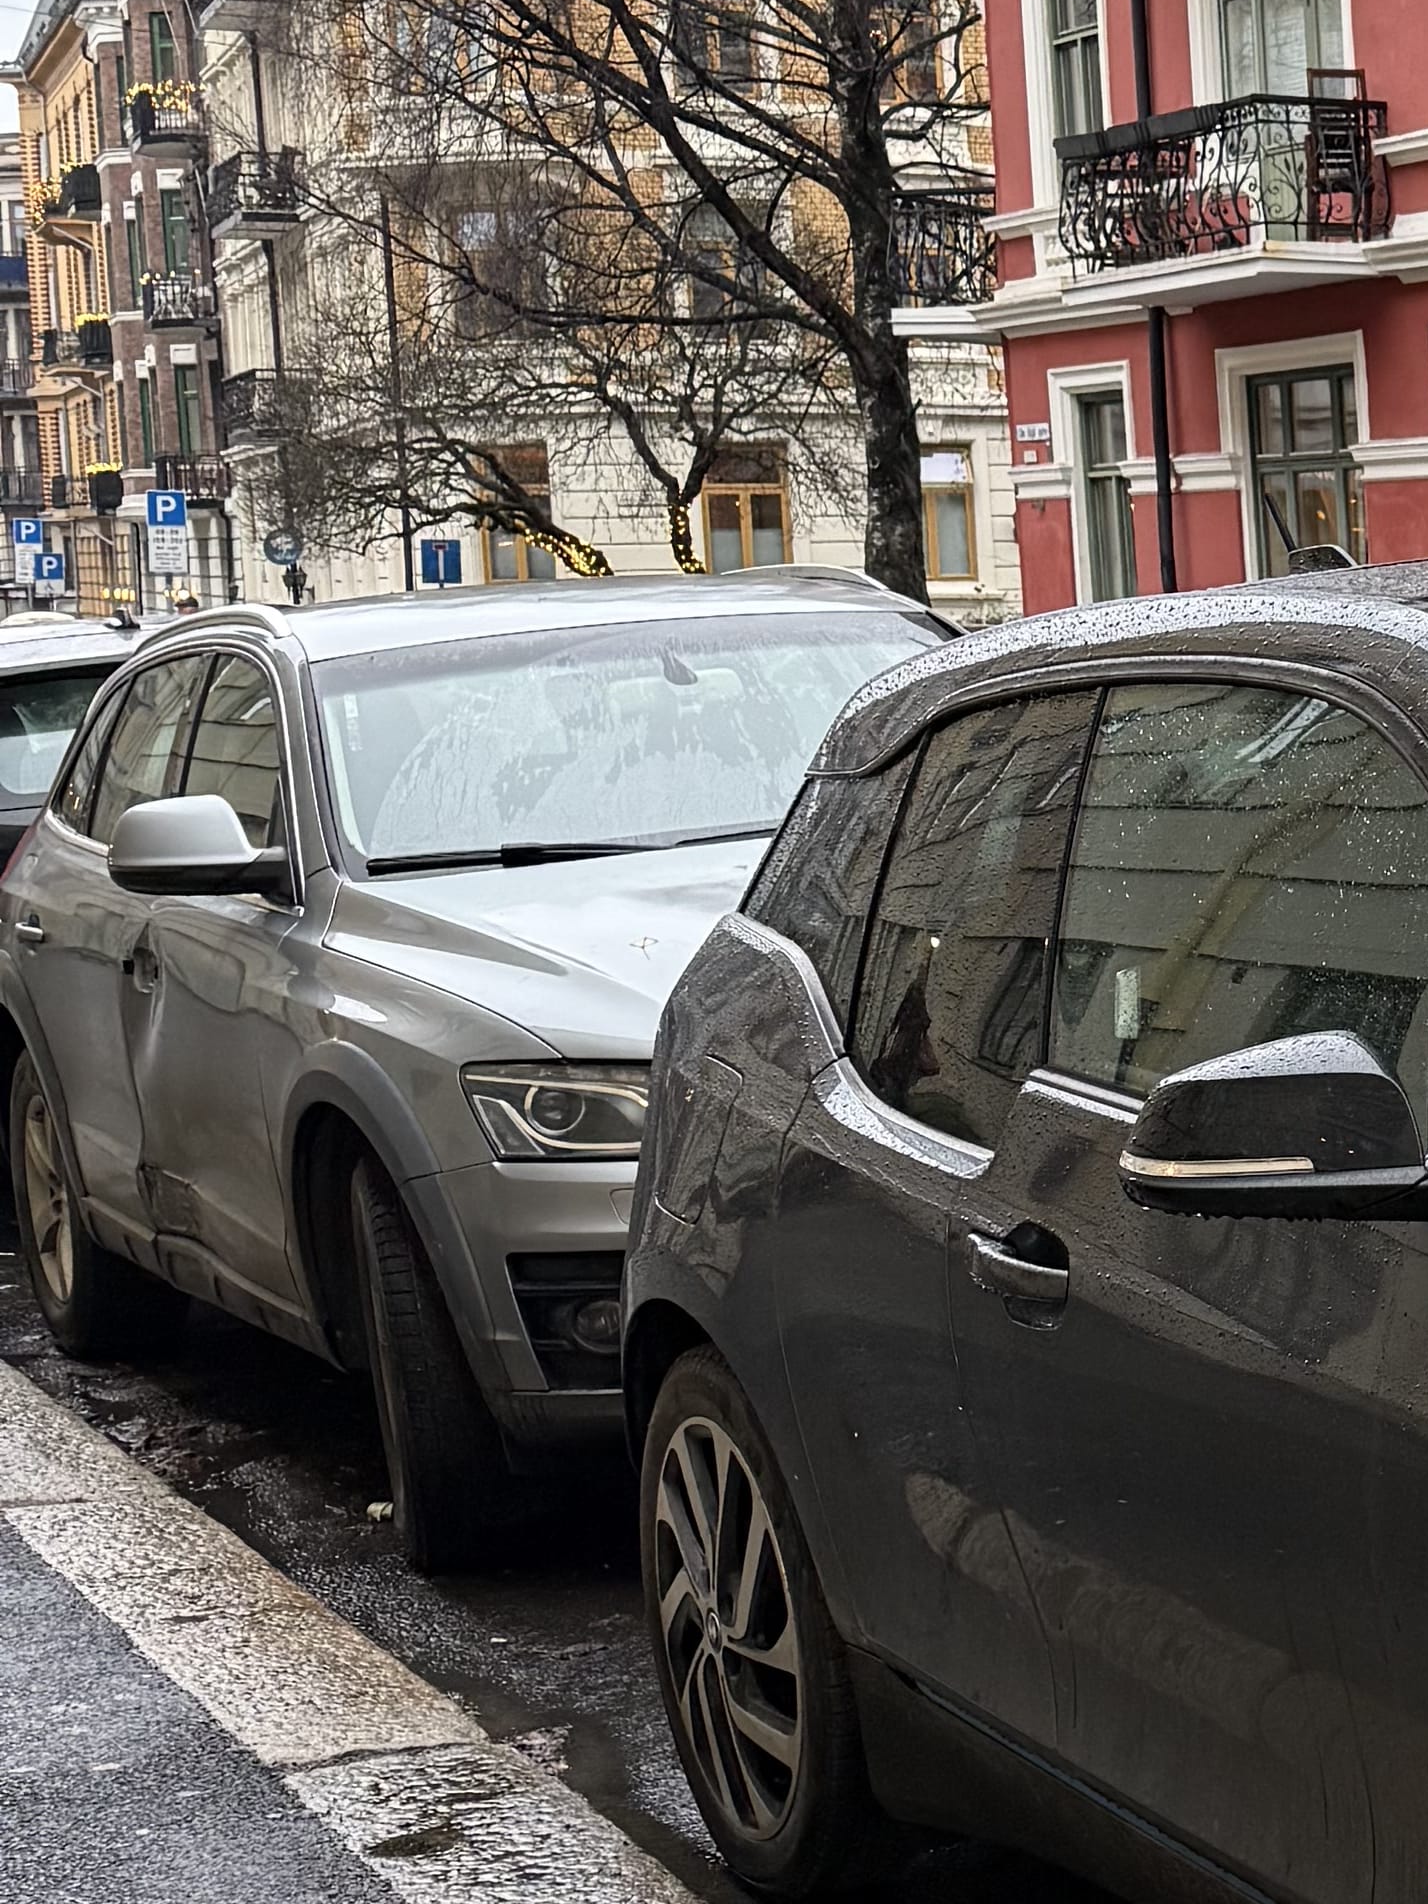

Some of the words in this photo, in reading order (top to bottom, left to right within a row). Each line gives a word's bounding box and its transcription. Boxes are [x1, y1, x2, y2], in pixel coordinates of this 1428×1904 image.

[155, 495, 177, 522] P
[20, 521, 36, 541] P
[42, 557, 58, 577] P
